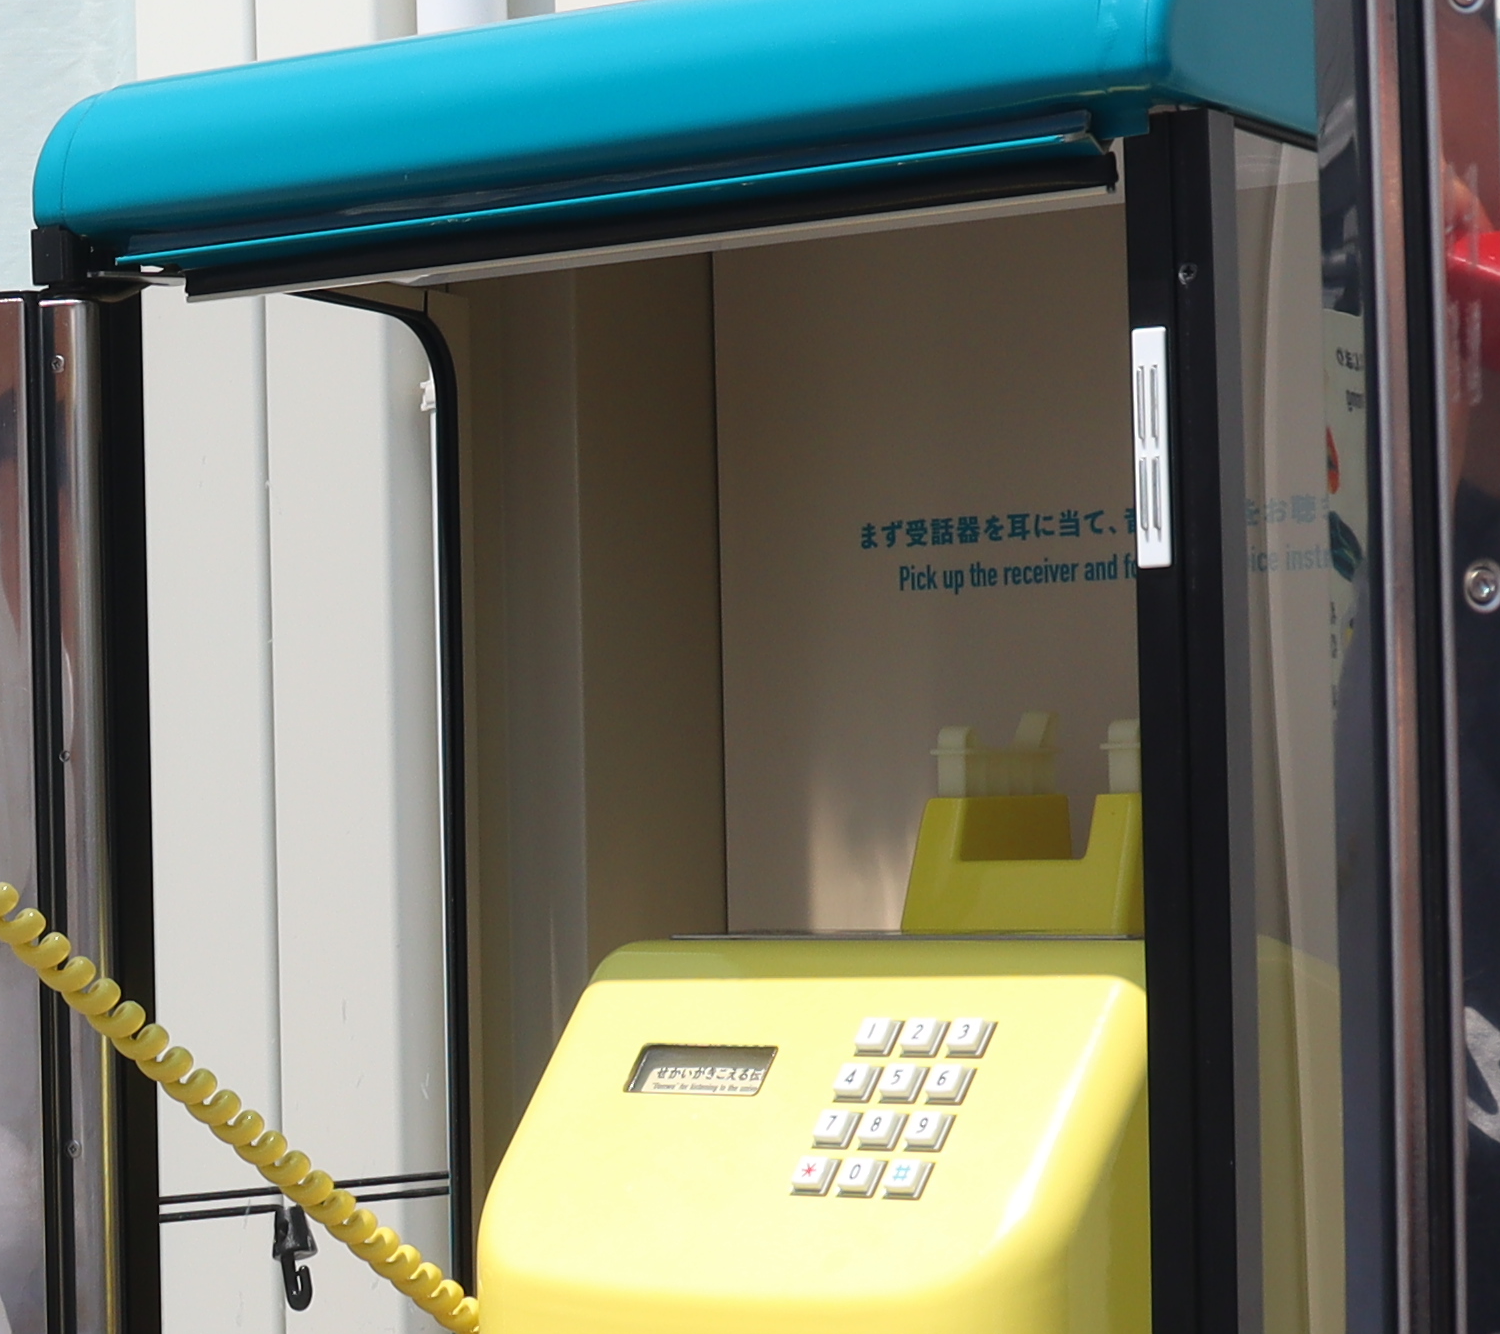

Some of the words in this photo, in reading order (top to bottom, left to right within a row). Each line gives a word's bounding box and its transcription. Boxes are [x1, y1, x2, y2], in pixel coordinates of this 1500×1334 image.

[899, 564, 937, 591] Pick
[944, 568, 964, 595] up
[970, 562, 997, 587] the
[1004, 558, 1079, 586] receiver
[1085, 554, 1117, 581] and
[867, 1023, 876, 1038] 1
[911, 1025, 924, 1040] 2
[957, 1025, 970, 1040] 3
[844, 1069, 856, 1085] 4
[891, 1069, 903, 1085] 5
[937, 1070, 948, 1086] 6
[827, 1115, 838, 1131] 7
[870, 1116, 882, 1132] 8
[917, 1117, 929, 1133] 9
[849, 1164, 861, 1180] 0
